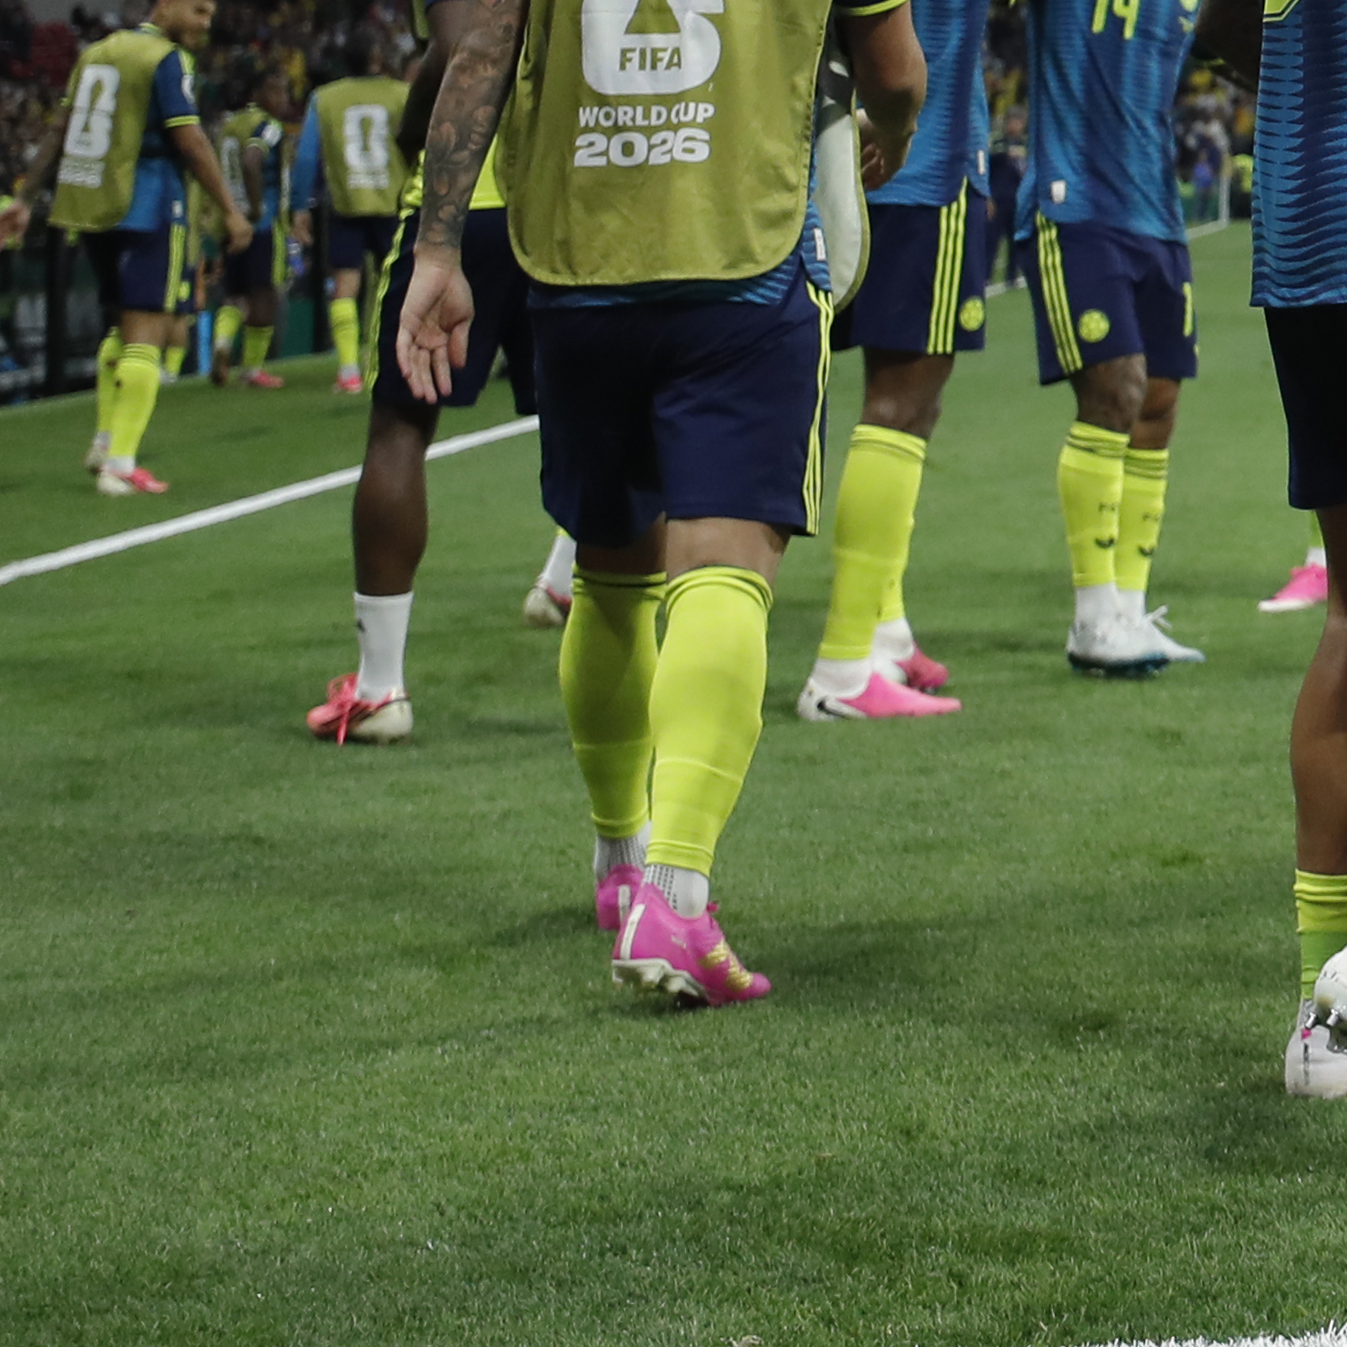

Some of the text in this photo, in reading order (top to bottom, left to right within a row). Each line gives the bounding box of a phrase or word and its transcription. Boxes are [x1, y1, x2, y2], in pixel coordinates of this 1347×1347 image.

[619, 47, 682, 71] FIFA
[579, 102, 716, 127] WORLD CUP
[574, 127, 710, 167] 2026
